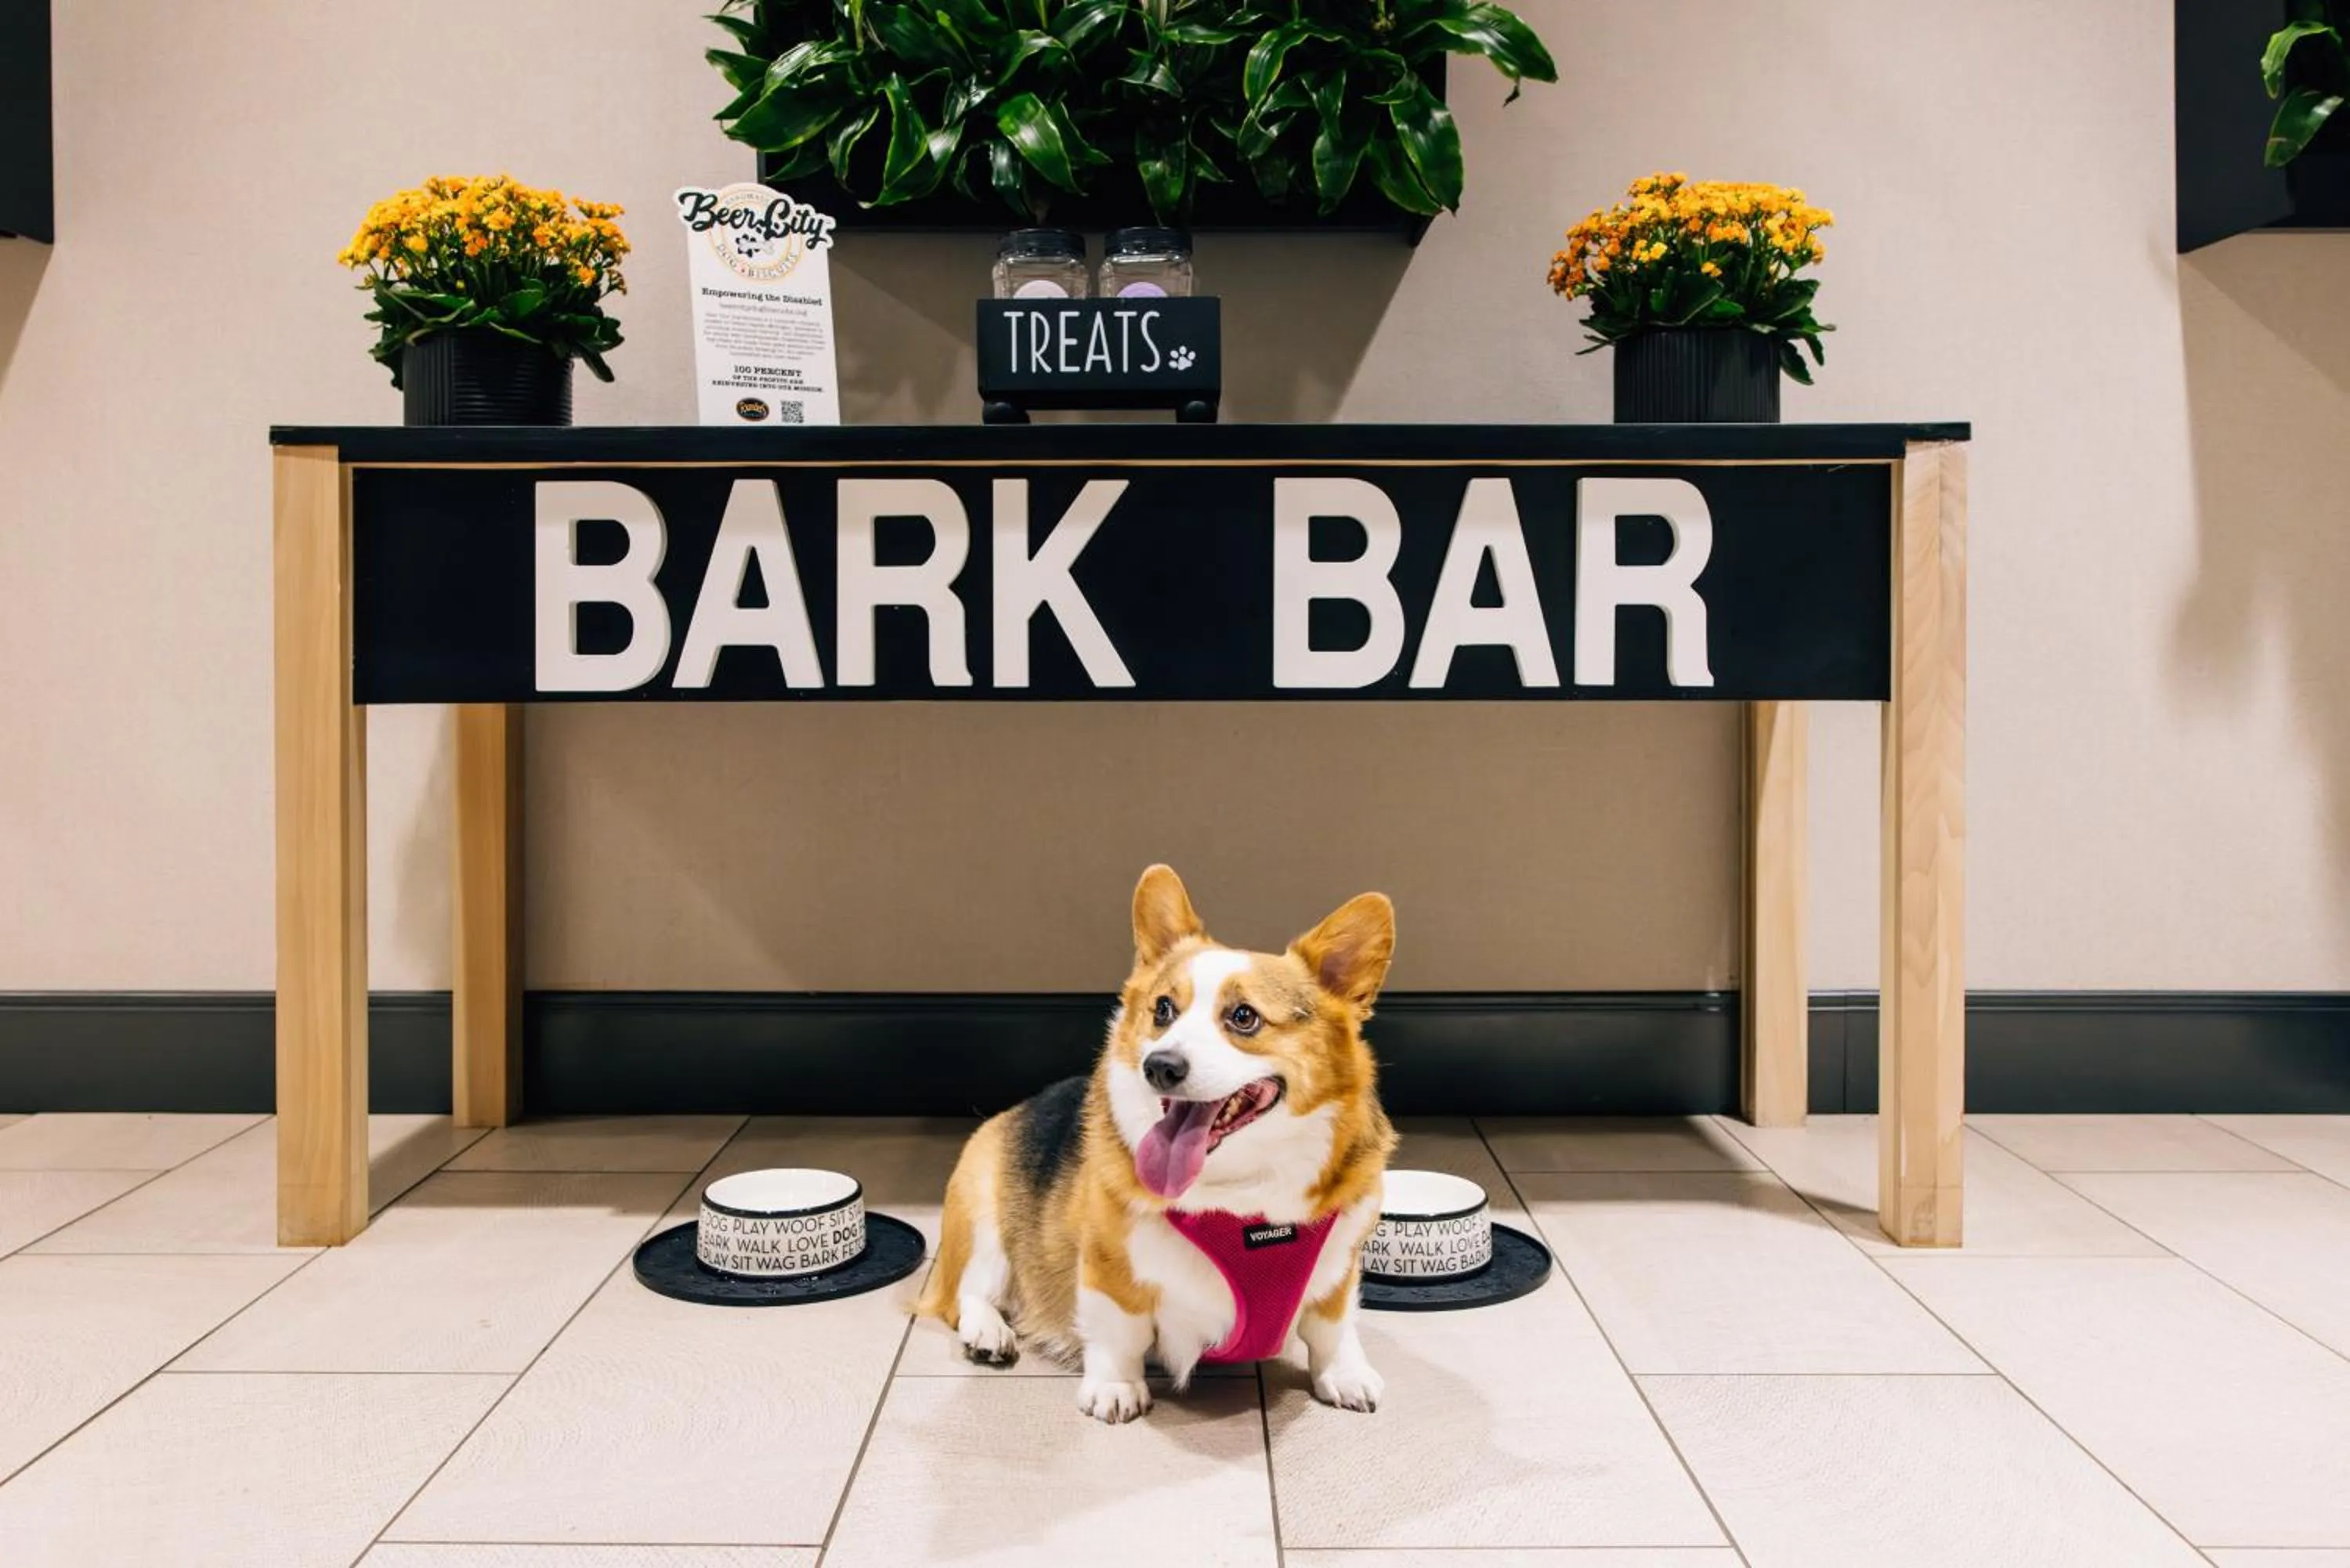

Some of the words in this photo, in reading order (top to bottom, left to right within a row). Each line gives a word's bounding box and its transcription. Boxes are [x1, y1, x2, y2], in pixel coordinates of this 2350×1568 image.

[678, 191, 761, 233] Beer
[760, 199, 828, 250] City
[765, 293, 781, 302] the
[1003, 311, 1160, 374] TREATS
[734, 365, 751, 374] 100
[754, 367, 802, 378] PERCENT
[534, 477, 1137, 692] BARK
[1272, 476, 1715, 689] BAR
[706, 1212, 728, 1232] DOG
[733, 1218, 770, 1235] PLAY
[773, 1216, 826, 1235] WOOF
[830, 1211, 845, 1228] SIT
[1249, 1227, 1292, 1241] VOYAGER
[1394, 1221, 1432, 1237] PLAY
[736, 1239, 780, 1254] WALK
[787, 1234, 829, 1253] LOVE
[832, 1225, 858, 1245] DOG
[1400, 1241, 1444, 1257] WALK
[1450, 1233, 1480, 1254] LOVE
[703, 1247, 729, 1267] PLAY
[732, 1255, 753, 1270] SIT
[756, 1255, 795, 1270] WAG
[801, 1250, 839, 1269] BARK
[1361, 1255, 1389, 1273] LAY
[1394, 1259, 1417, 1274] SIT
[1419, 1257, 1458, 1273] WAG
